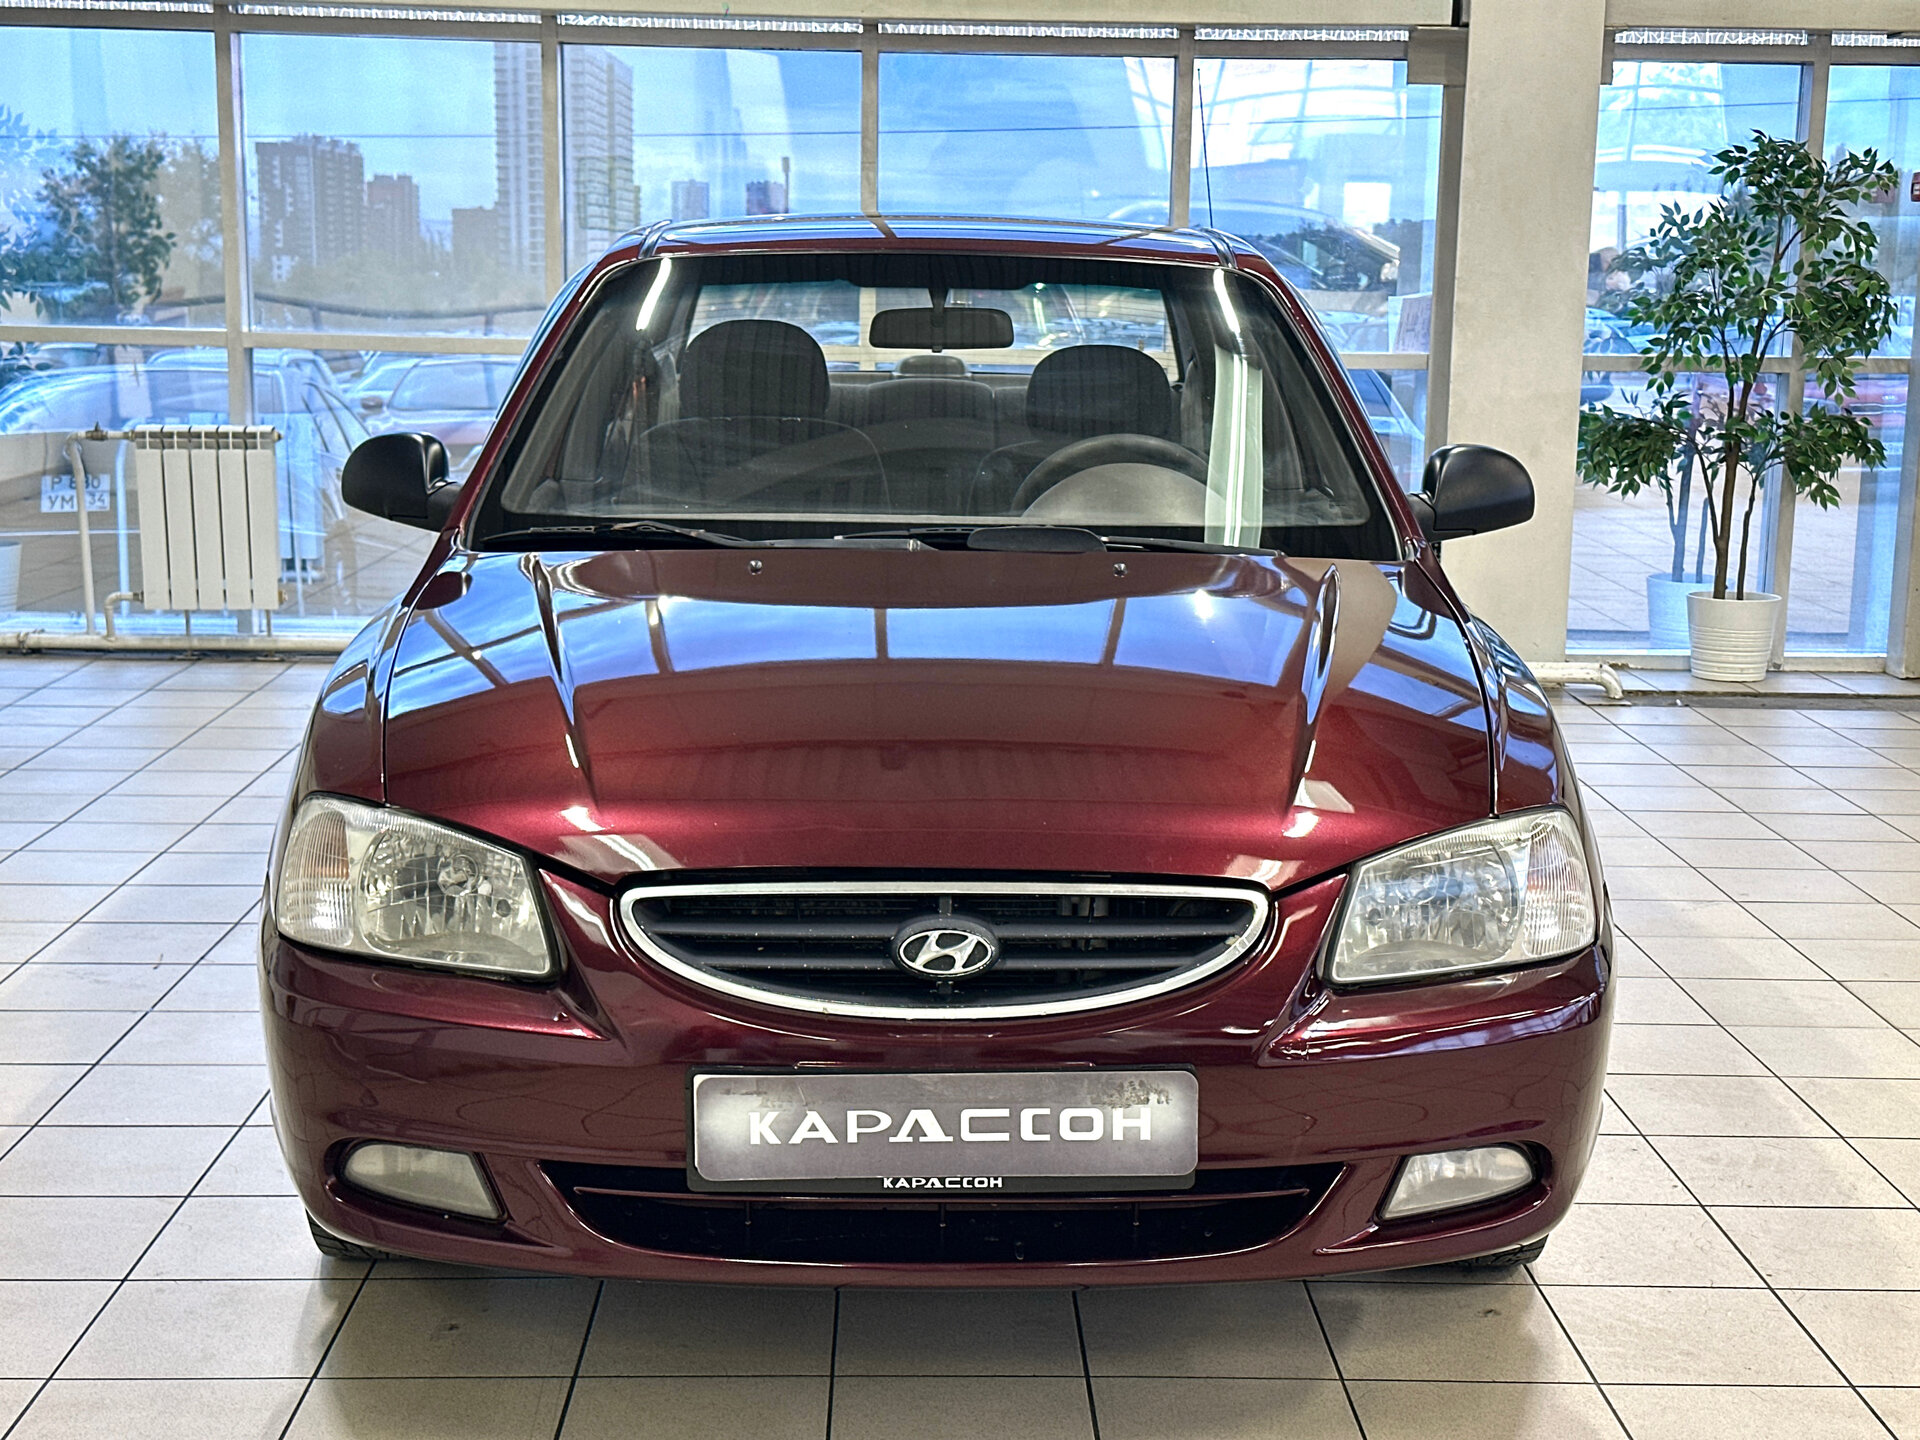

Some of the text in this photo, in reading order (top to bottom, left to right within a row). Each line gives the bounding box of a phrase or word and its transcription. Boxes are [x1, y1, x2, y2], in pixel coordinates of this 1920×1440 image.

[48, 494, 75, 510] УМ
[748, 1106, 1152, 1145] КАРАССОН
[883, 1176, 1003, 1189] КАРАССОН
